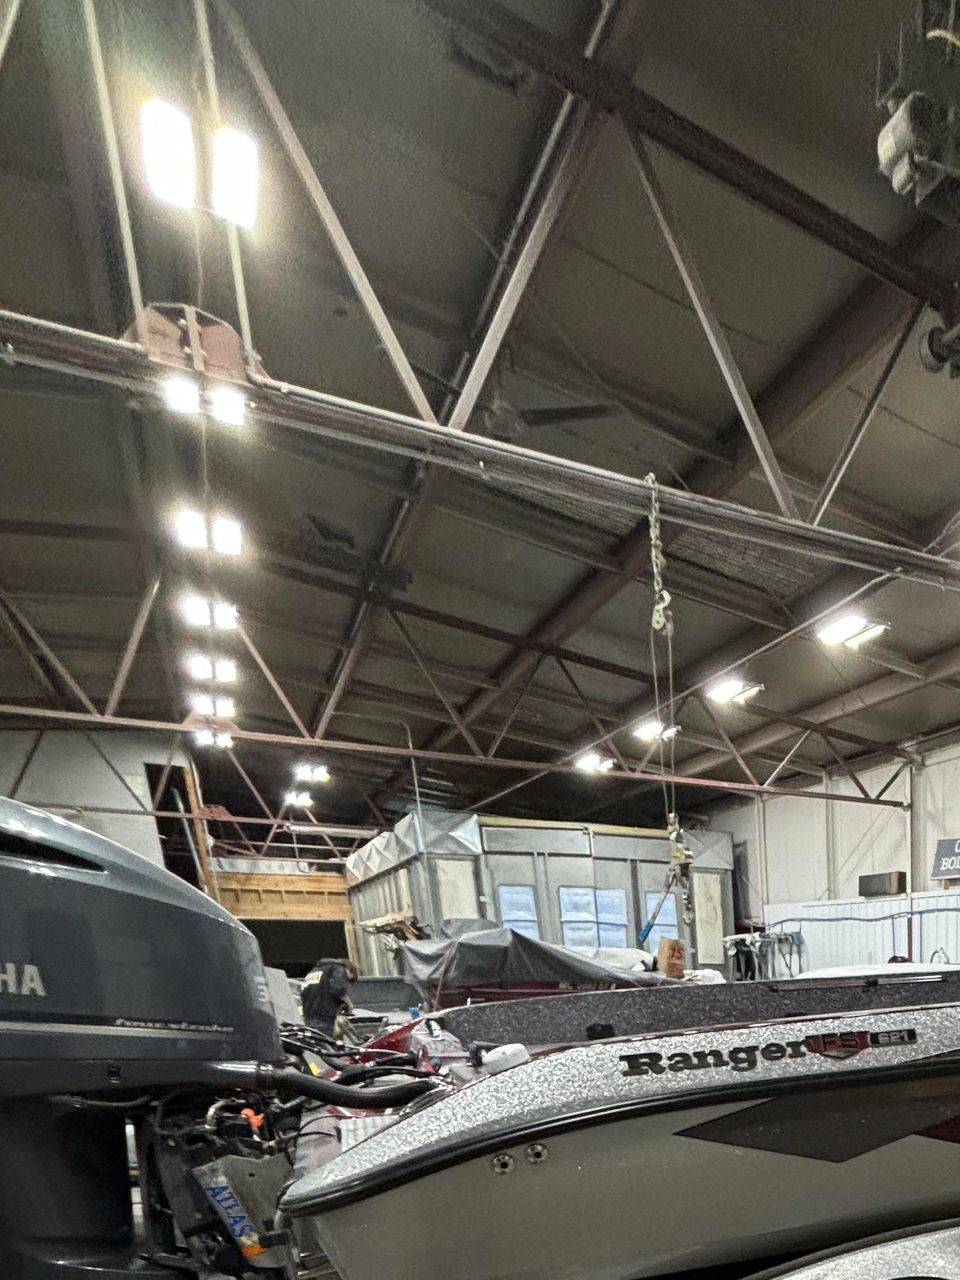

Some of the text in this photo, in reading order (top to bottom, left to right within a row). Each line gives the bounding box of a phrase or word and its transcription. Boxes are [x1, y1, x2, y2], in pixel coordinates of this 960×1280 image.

[619, 1041, 807, 1077] Ranger
[877, 1030, 910, 1044] 621
[206, 1185, 254, 1238] ATLAS
